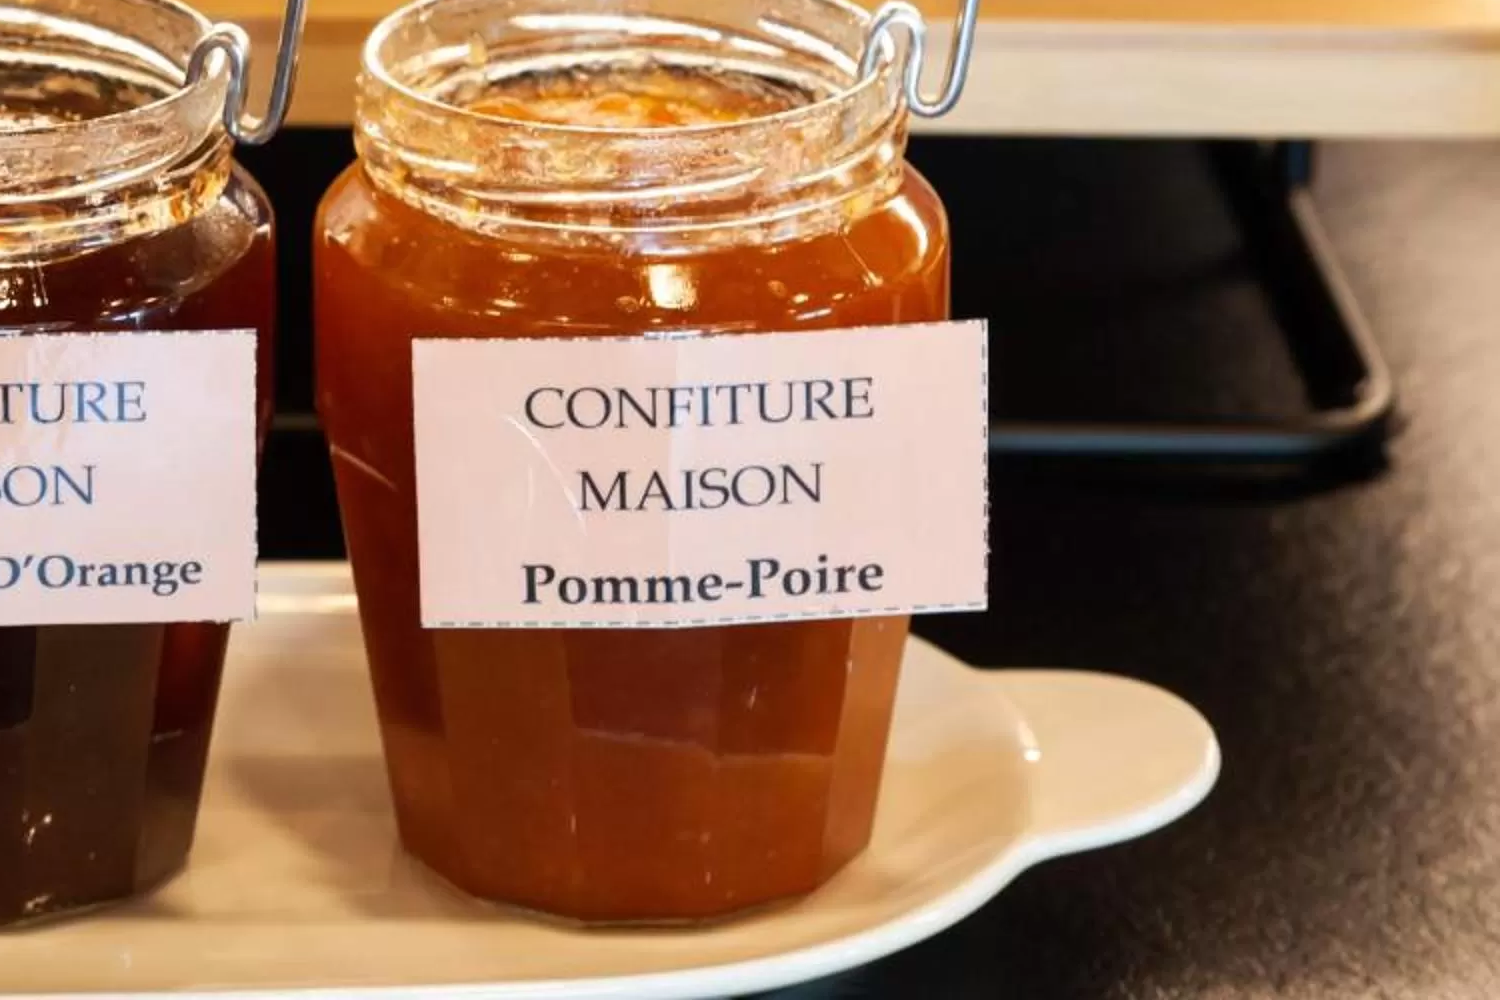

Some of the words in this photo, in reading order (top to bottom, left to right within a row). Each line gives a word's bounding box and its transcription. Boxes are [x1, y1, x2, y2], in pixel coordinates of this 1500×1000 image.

[523, 376, 875, 430] CONFITURE
[578, 462, 822, 513] MAISON
[521, 553, 885, 605] Pomme-Poire
